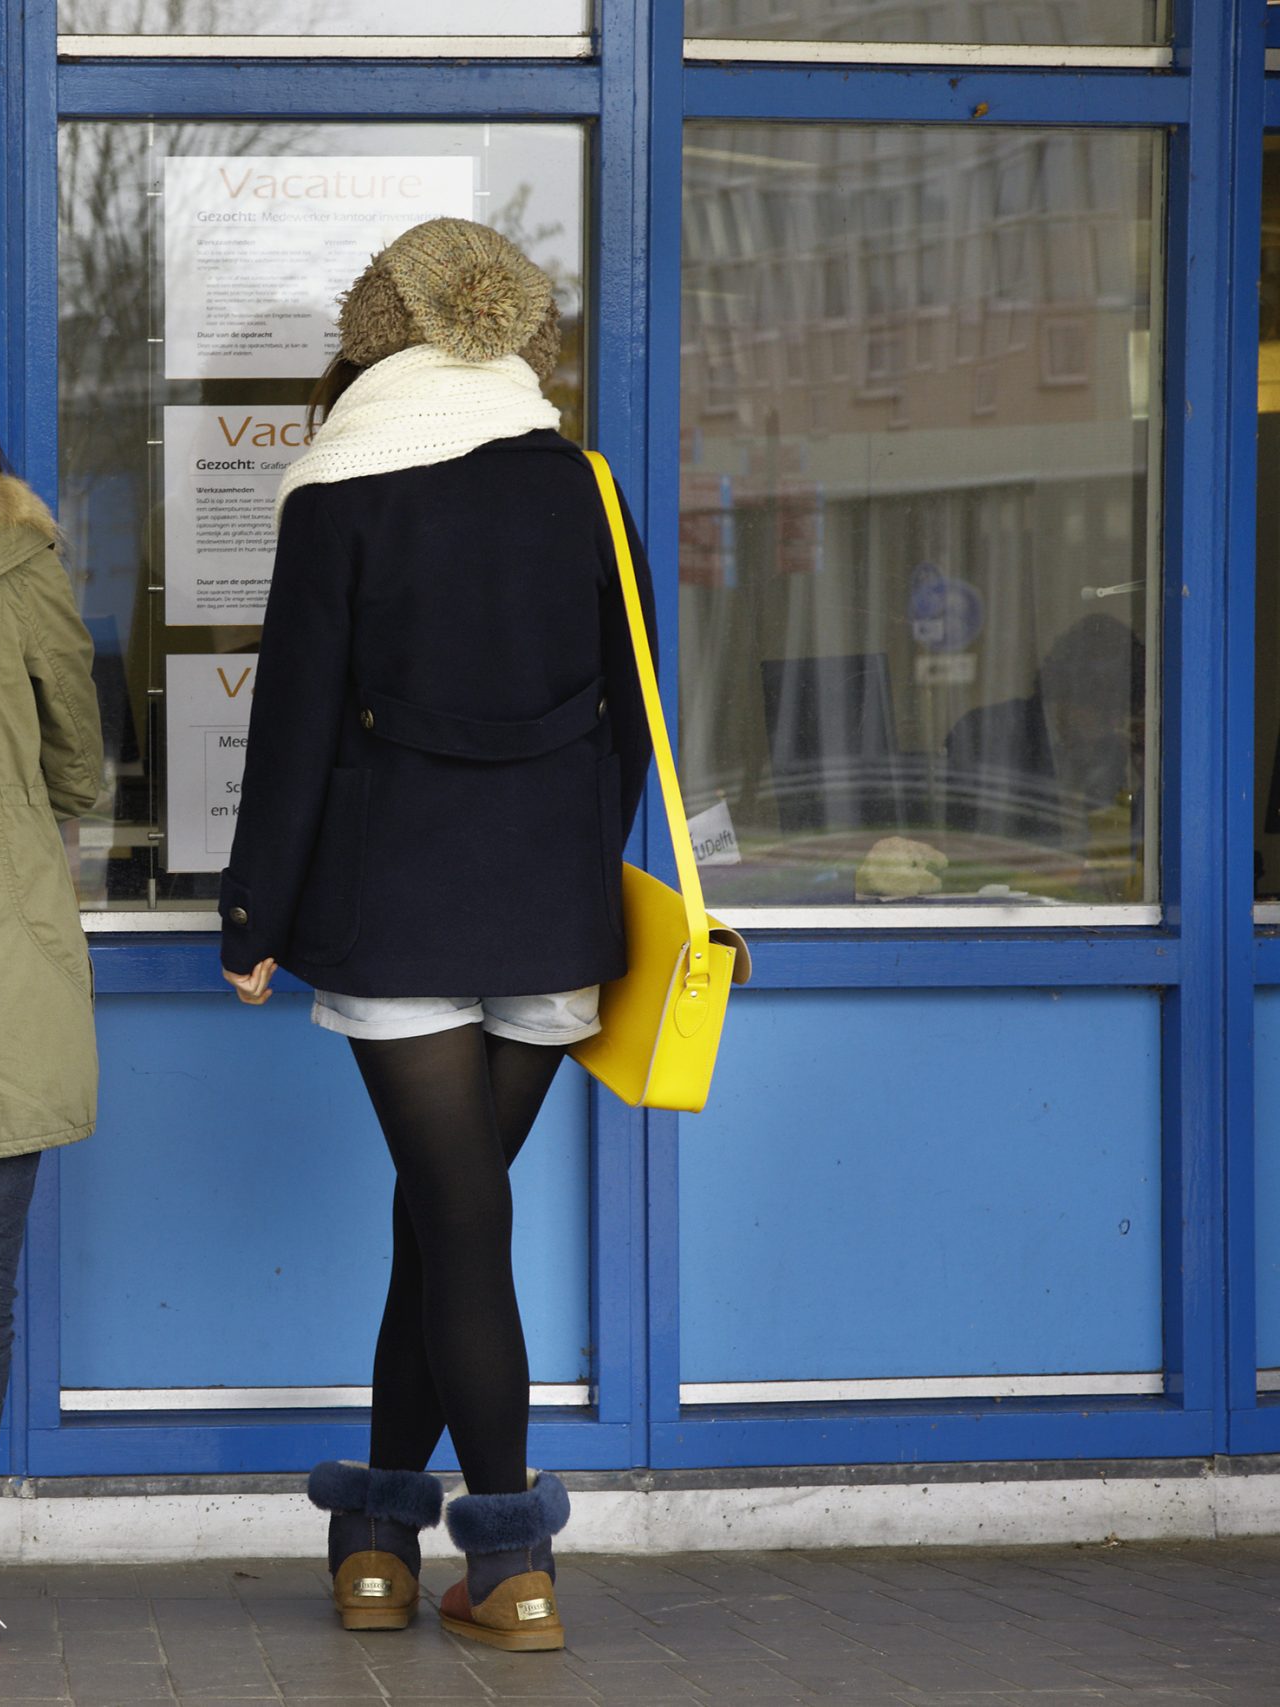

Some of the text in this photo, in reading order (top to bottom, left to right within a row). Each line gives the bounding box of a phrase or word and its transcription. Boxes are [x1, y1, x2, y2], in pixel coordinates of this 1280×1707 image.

[219, 167, 422, 199] Vacature
[197, 210, 256, 223] Gezocht:
[262, 211, 331, 222] Medewerker
[334, 211, 376, 222] kantoor
[196, 459, 255, 470] Gezocht:
[211, 806, 228, 816] en
